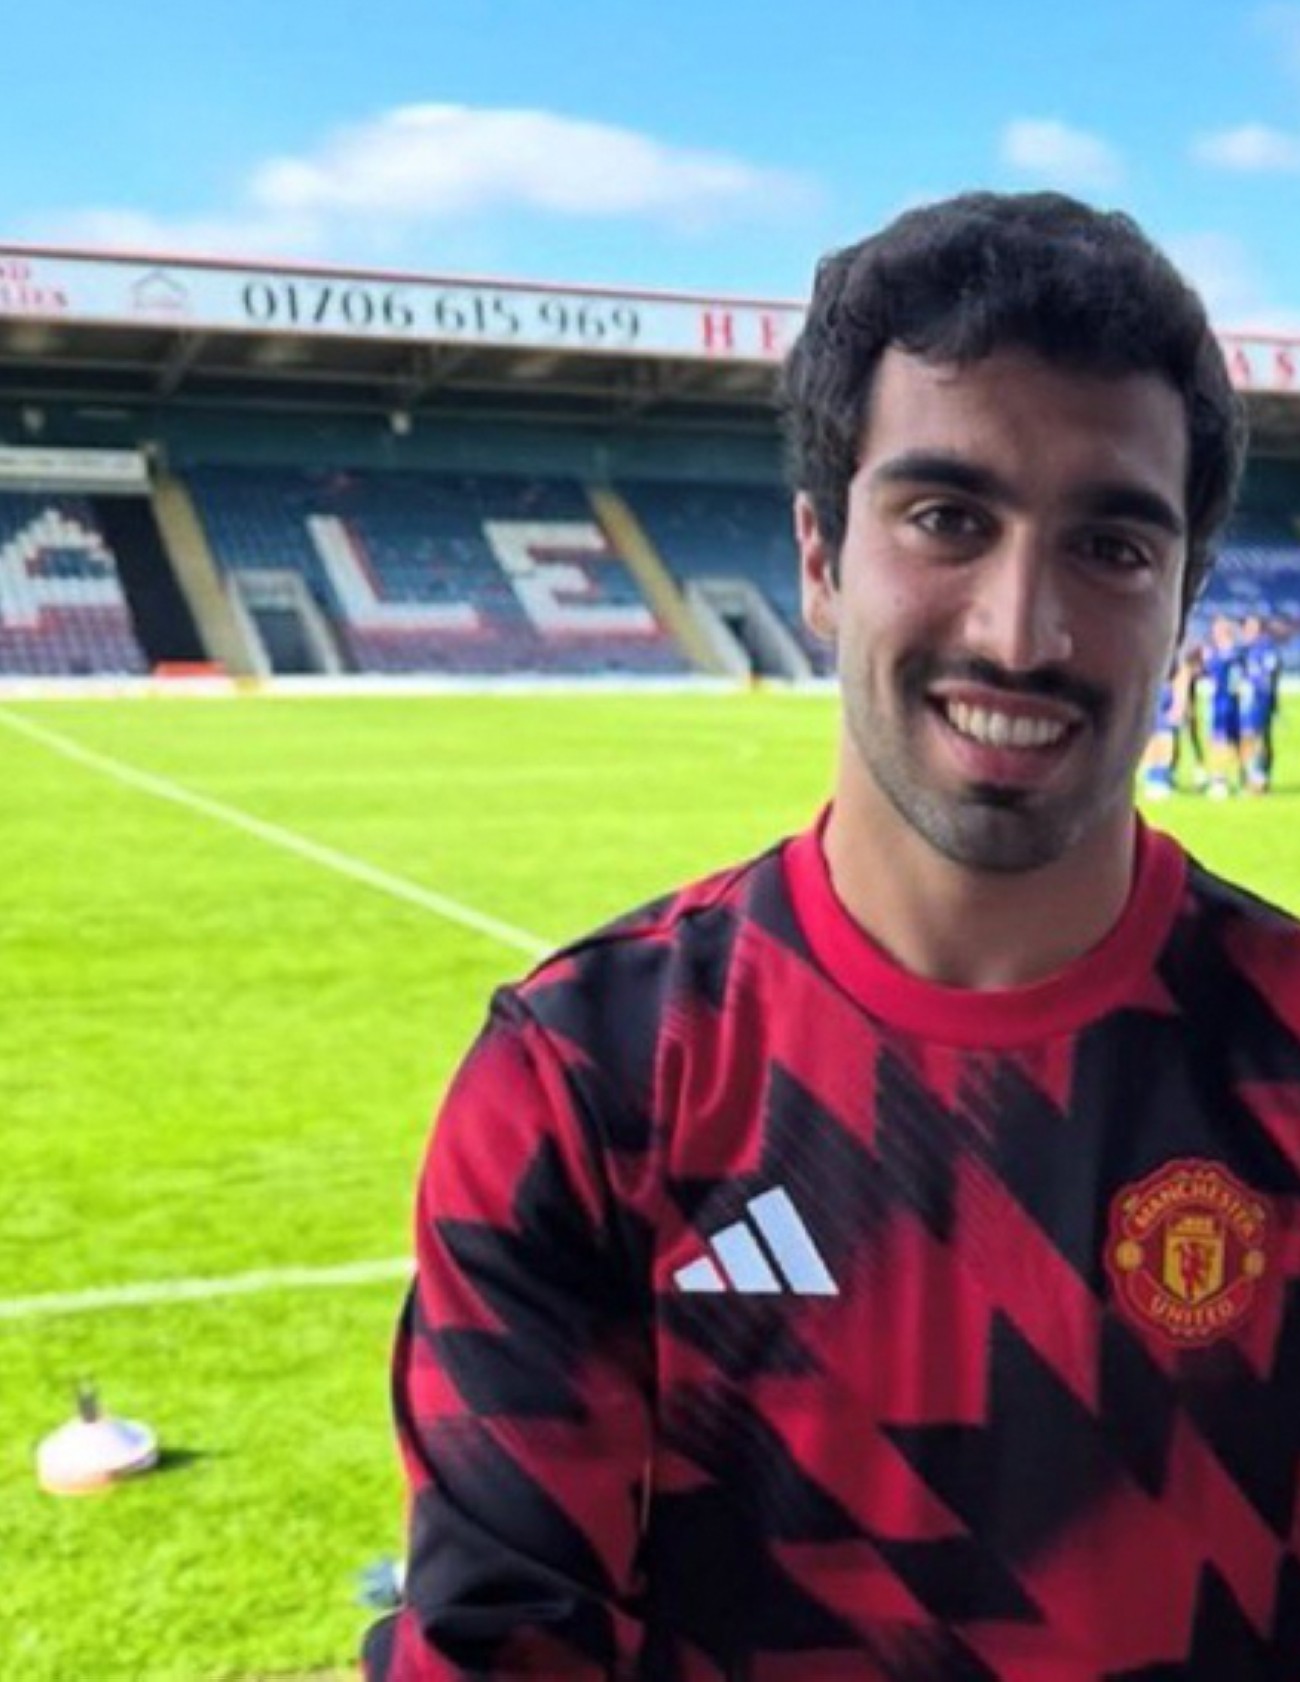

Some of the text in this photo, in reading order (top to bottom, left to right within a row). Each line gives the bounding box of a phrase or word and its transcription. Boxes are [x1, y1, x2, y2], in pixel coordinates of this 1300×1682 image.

[242, 279, 641, 339] 01706 615 969
